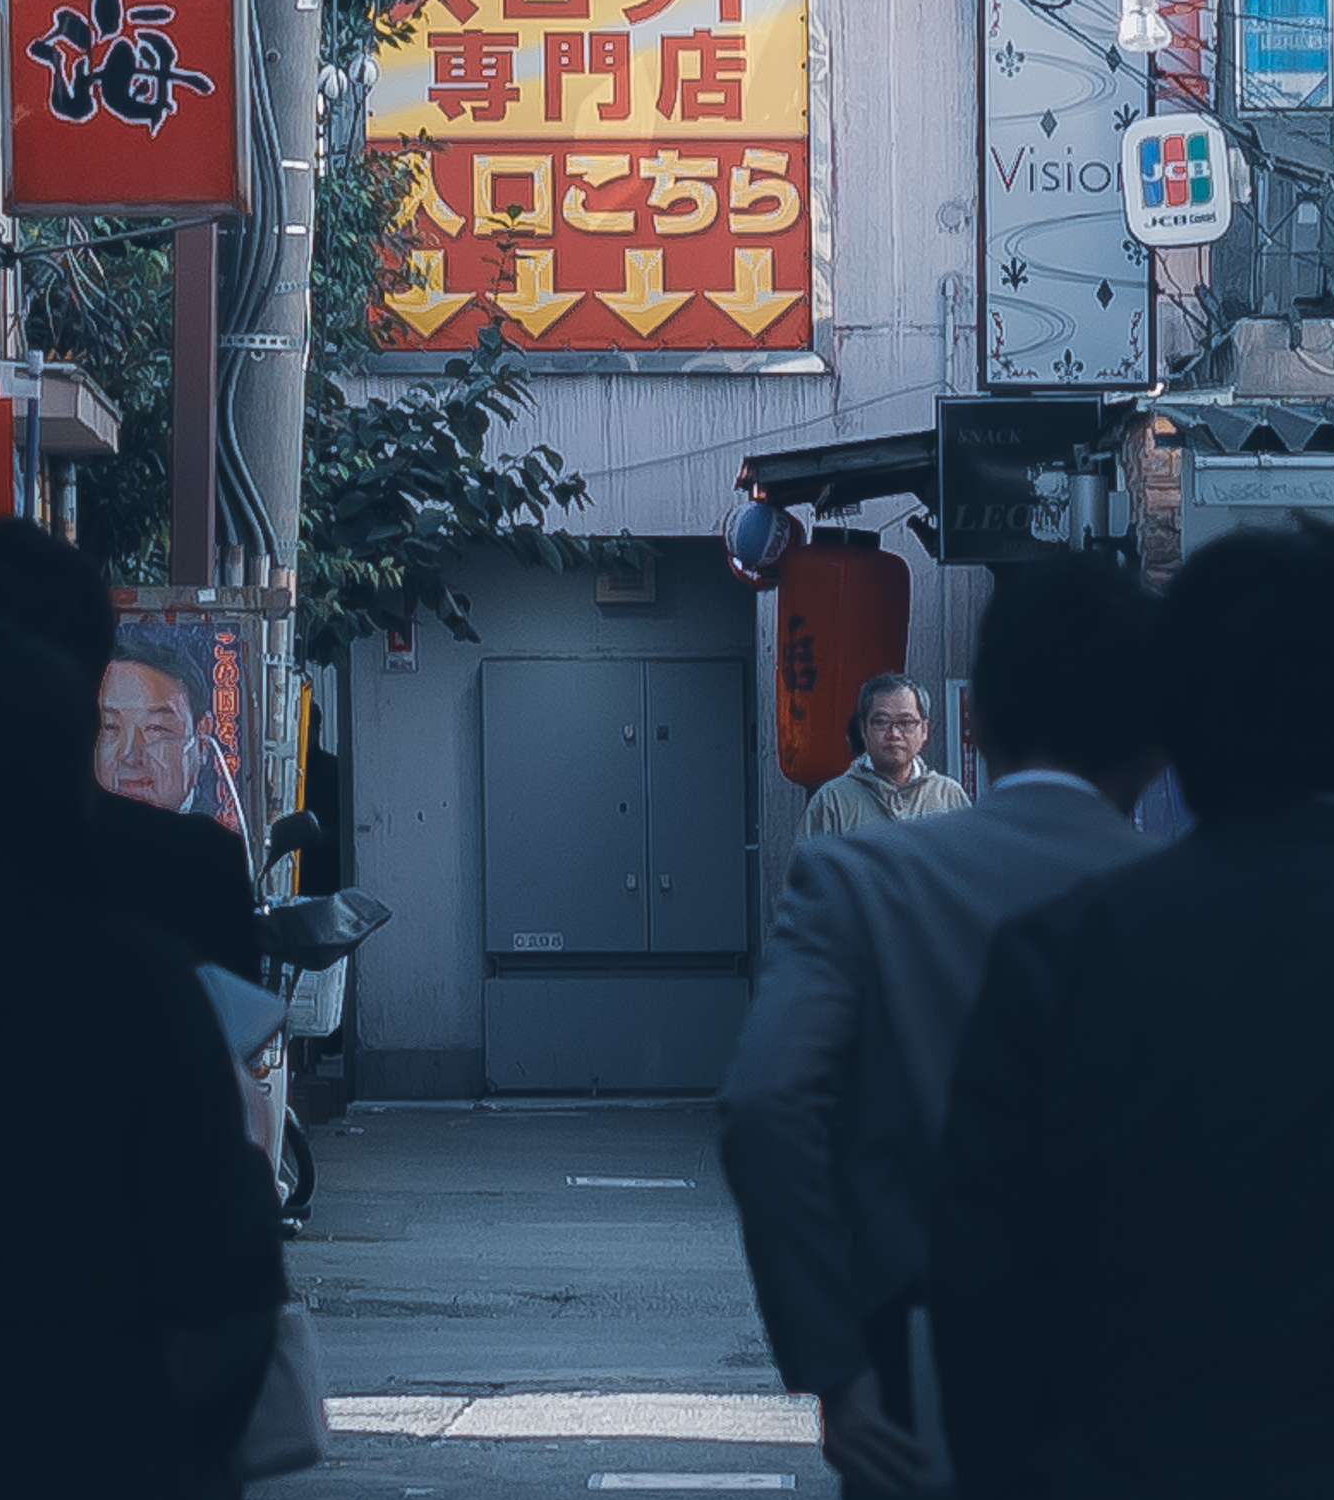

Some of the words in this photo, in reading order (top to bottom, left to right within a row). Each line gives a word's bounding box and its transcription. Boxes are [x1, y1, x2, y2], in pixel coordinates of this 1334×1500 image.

[427, 28, 747, 123] 専門店
[990, 145, 1123, 193] Visio
[1142, 159, 1211, 182] JCB
